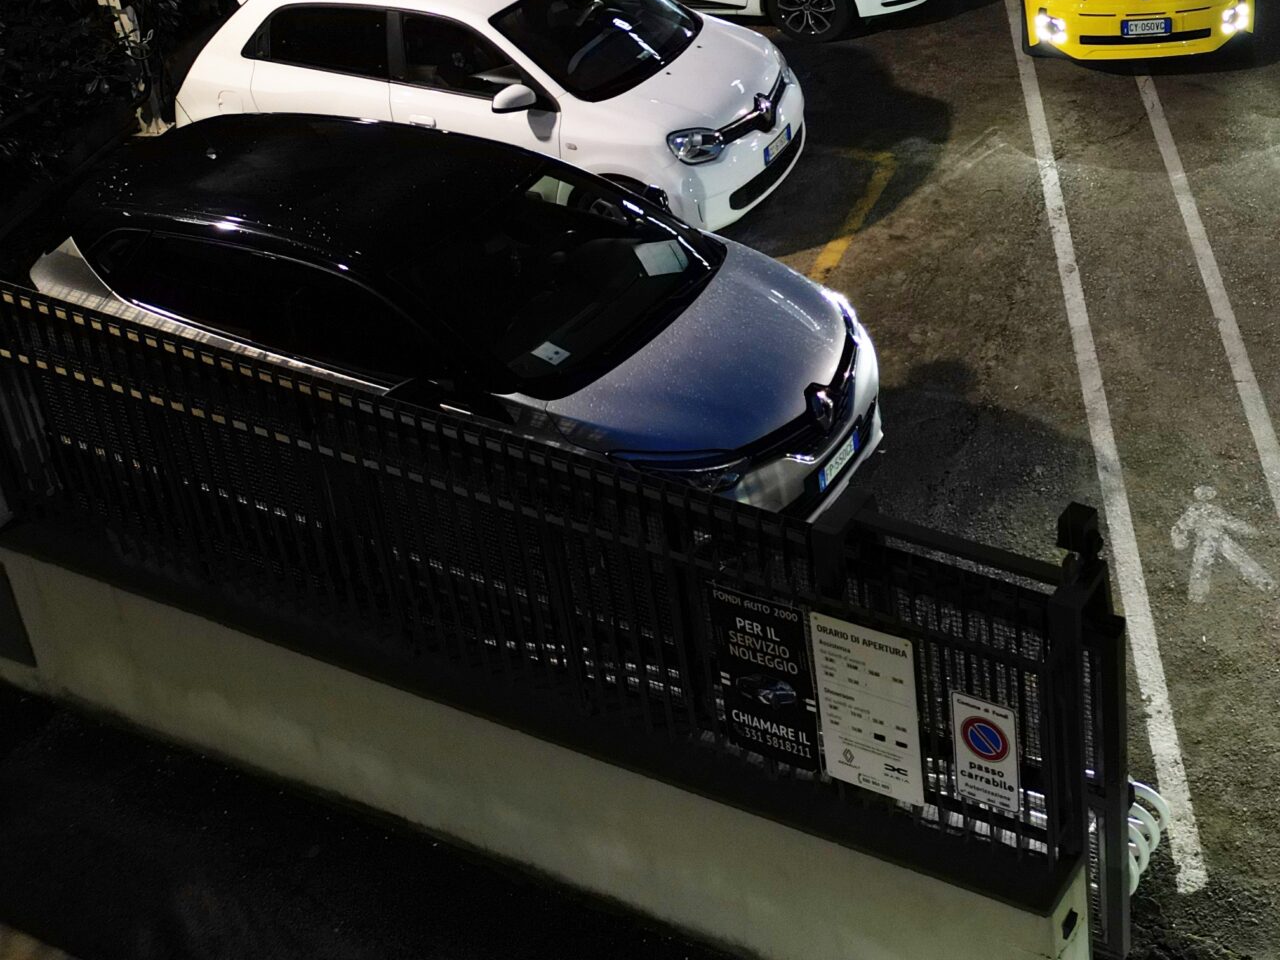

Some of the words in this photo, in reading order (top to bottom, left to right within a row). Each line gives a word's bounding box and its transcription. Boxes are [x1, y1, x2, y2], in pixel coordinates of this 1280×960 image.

[712, 589, 742, 606] FONDI
[744, 599, 770, 615] AUTO
[773, 608, 798, 622] 2000
[735, 617, 764, 637] PER
[766, 625, 781, 642] IL
[816, 624, 849, 641] ORARIO
[850, 635, 860, 644] DI
[862, 638, 908, 658] APERTURA
[728, 630, 790, 660] SERVIZIO
[729, 643, 799, 675] NOLEGGIO
[956, 698, 981, 711] Comune
[731, 709, 796, 741] CHIAMARE
[799, 731, 811, 746] IL
[744, 726, 762, 743] 331
[960, 769, 1015, 793] carrabile
[968, 761, 1005, 778] passo
